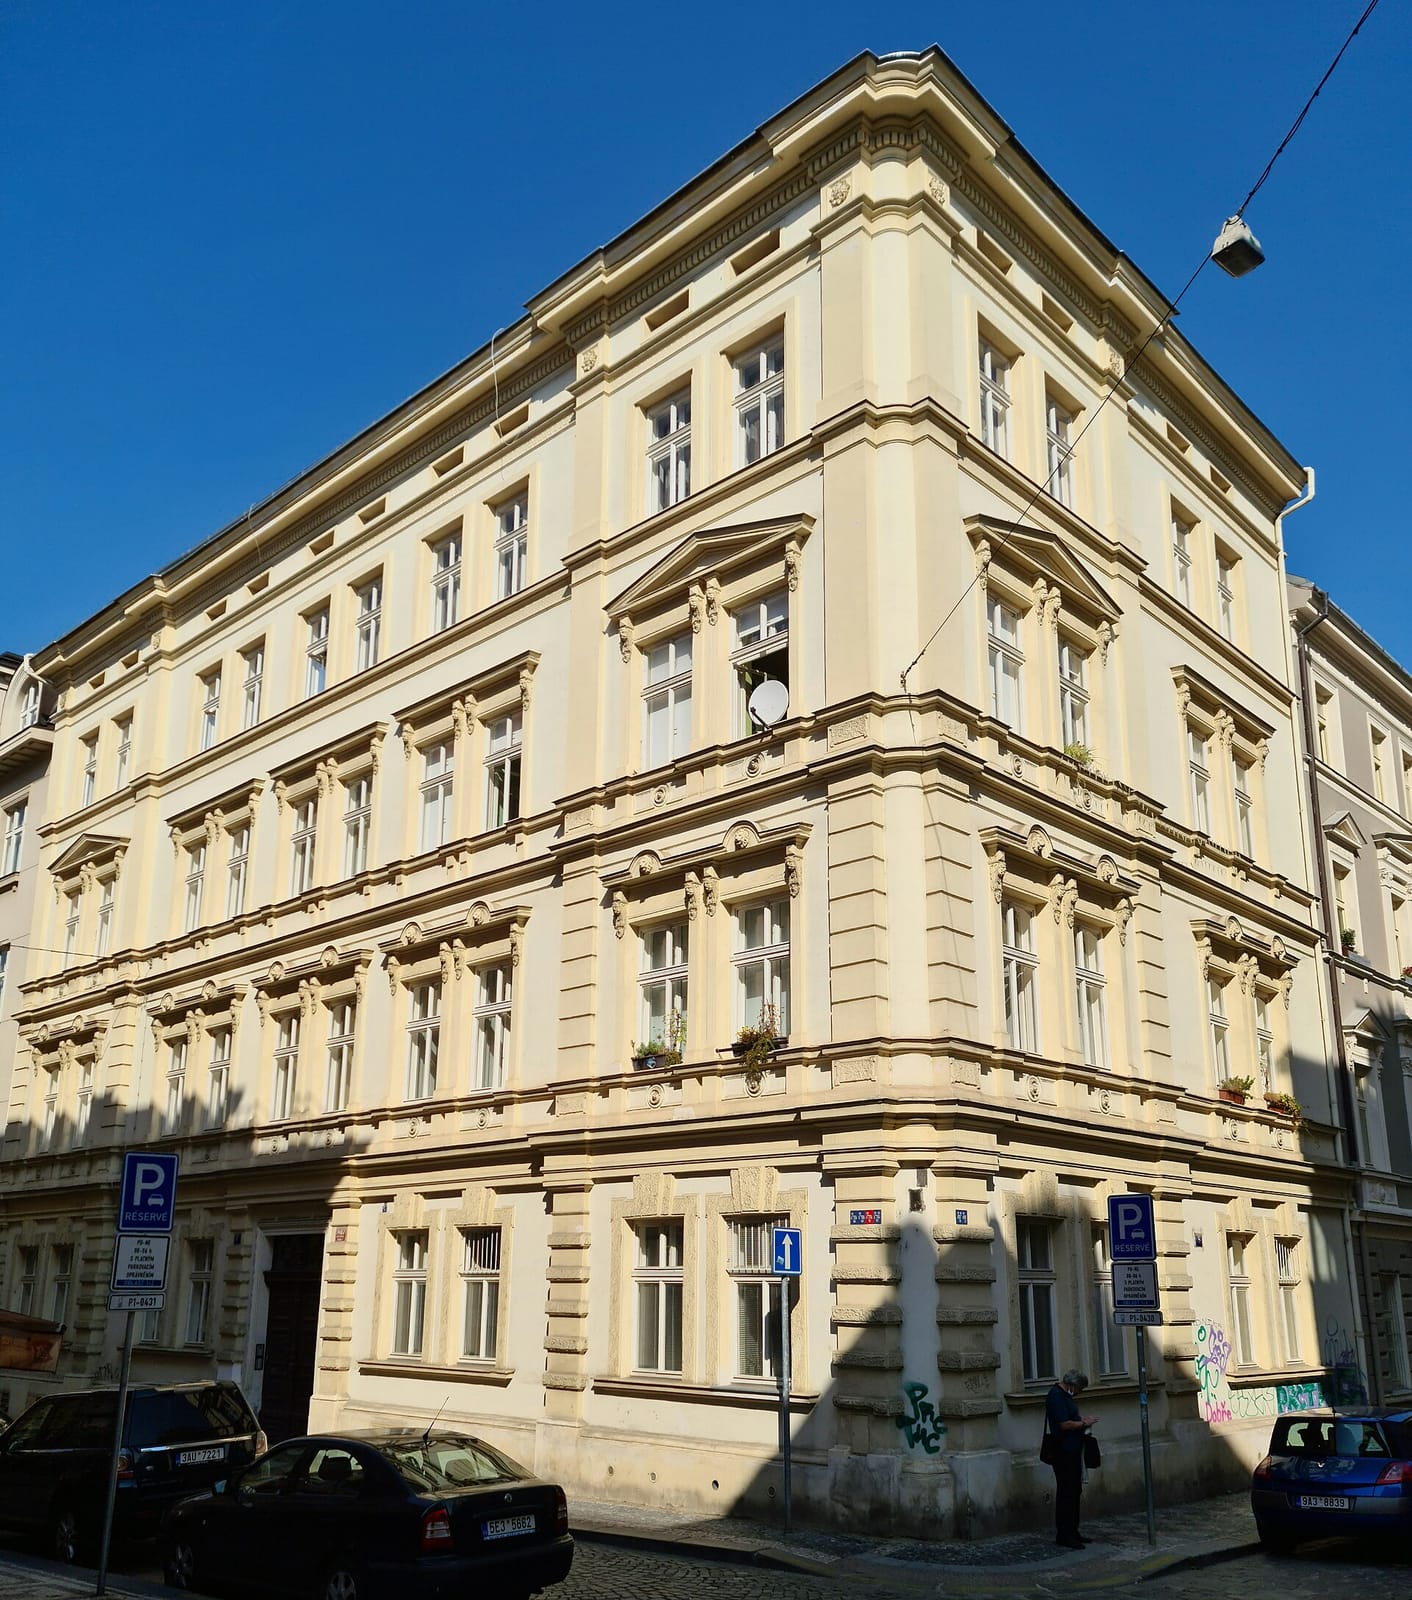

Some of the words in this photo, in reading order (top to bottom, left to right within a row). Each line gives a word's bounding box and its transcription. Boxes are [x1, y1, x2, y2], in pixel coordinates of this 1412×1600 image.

[133, 1163, 165, 1206] P
[1118, 1203, 1143, 1240] P
[128, 1298, 157, 1307] P1-0431
[1129, 1314, 1155, 1323] P1-0430
[1206, 1401, 1232, 1423] Dobře
[490, 1520, 505, 1534] 5E3
[511, 1516, 532, 1530] 5662
